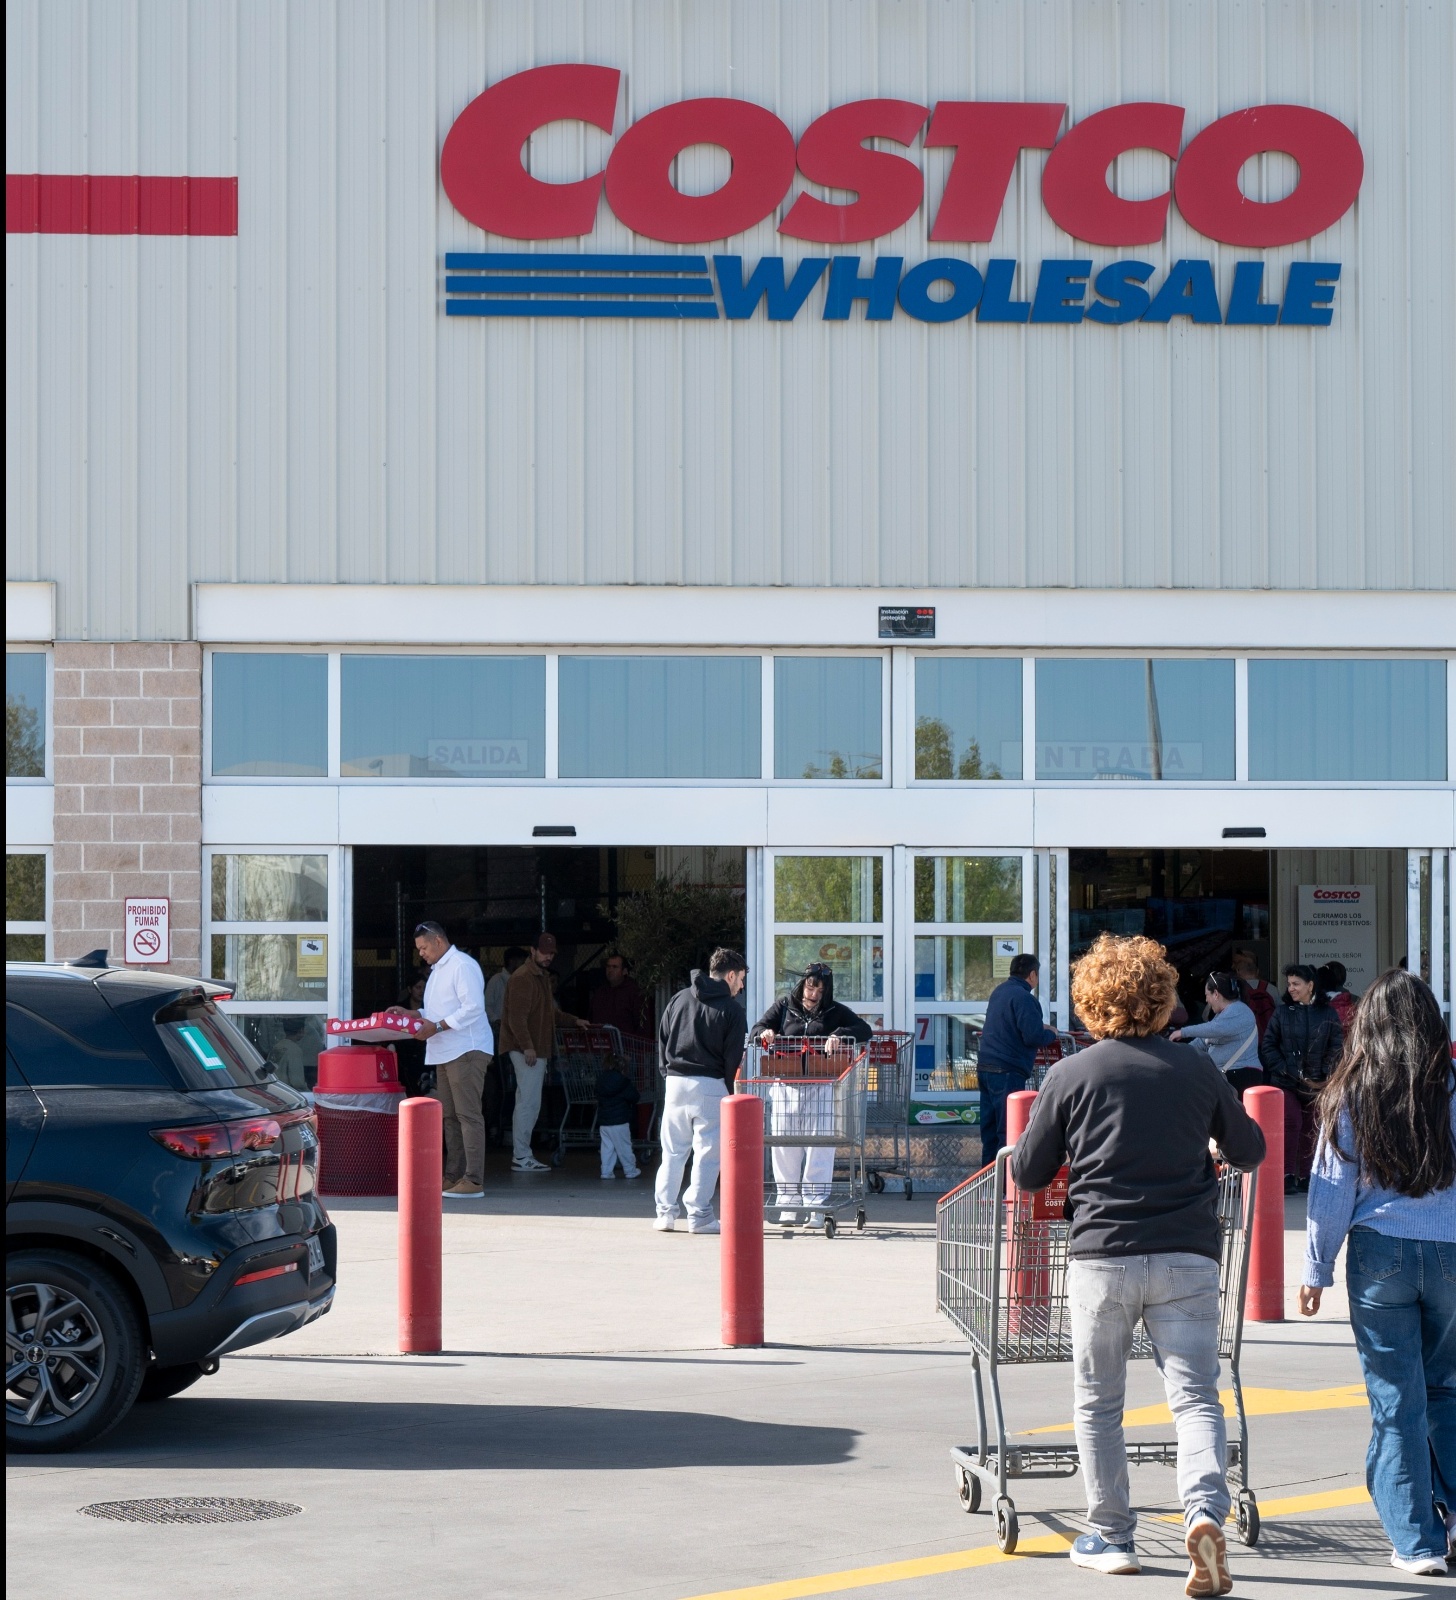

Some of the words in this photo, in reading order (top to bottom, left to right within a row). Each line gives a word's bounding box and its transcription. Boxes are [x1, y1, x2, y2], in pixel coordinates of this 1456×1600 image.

[441, 63, 1364, 248] COSTCO
[713, 254, 1341, 326] WHOLESALE
[435, 745, 522, 765] SALIDA
[1035, 746, 1185, 769] NTRAA
[1313, 889, 1361, 899] COSTCO
[127, 905, 167, 915] PROHIBIDO
[134, 916, 160, 926] FUMAR
[917, 1018, 930, 1040] 7
[183, 1031, 224, 1067] L
